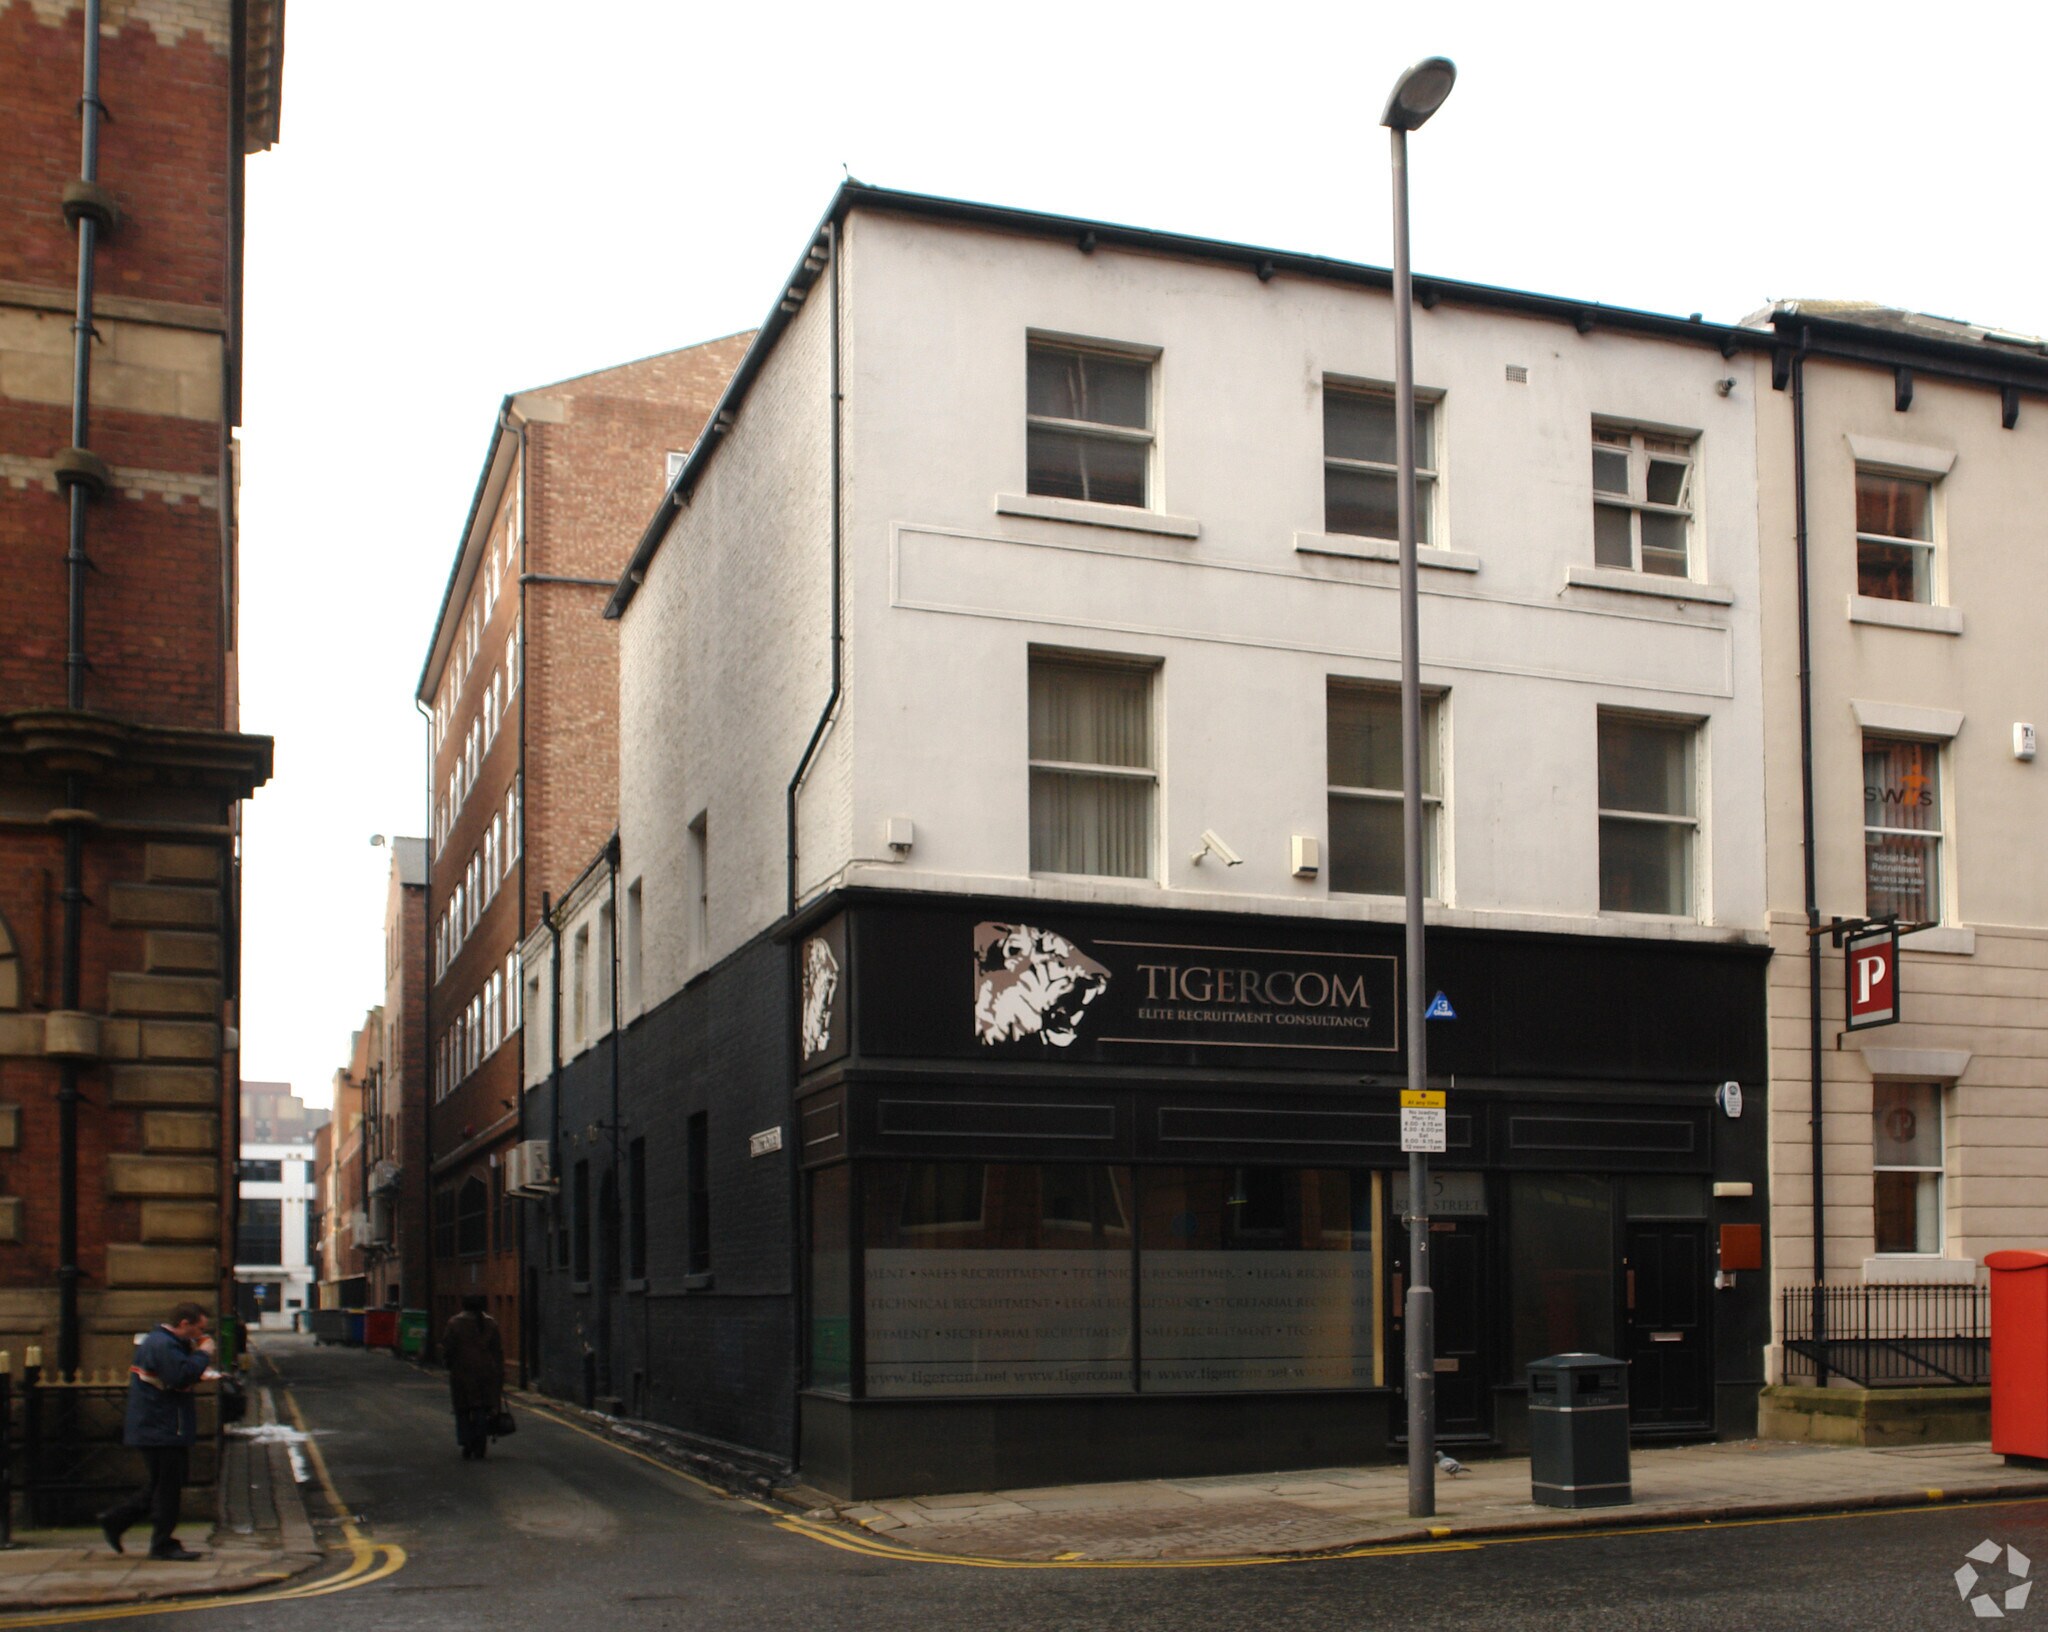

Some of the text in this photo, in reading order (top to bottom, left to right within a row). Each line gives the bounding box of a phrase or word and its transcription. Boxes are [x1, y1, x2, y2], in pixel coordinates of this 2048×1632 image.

[1873, 853, 1920, 864] Social Care
[1872, 862, 1921, 874] Recruitment
[1857, 956, 1886, 1004] P
[1137, 964, 1371, 1008] TIGERCOM
[1138, 1008, 1371, 1028] ELITE RECRUITMENT CONSULTANCY
[1432, 1175, 1444, 1196] 5
[1433, 1200, 1479, 1210] STREET
[1420, 1242, 1427, 1251] 2
[921, 1268, 957, 1279] SALES
[961, 1268, 1057, 1279] RECRUITMENT
[1257, 1268, 1292, 1279] LEGAL
[872, 1298, 948, 1309] TECHNICAL
[953, 1298, 1050, 1309] RECRUITMENT
[1065, 1298, 1102, 1309] LEGAL
[944, 1328, 1031, 1339] SECRETARIAL
